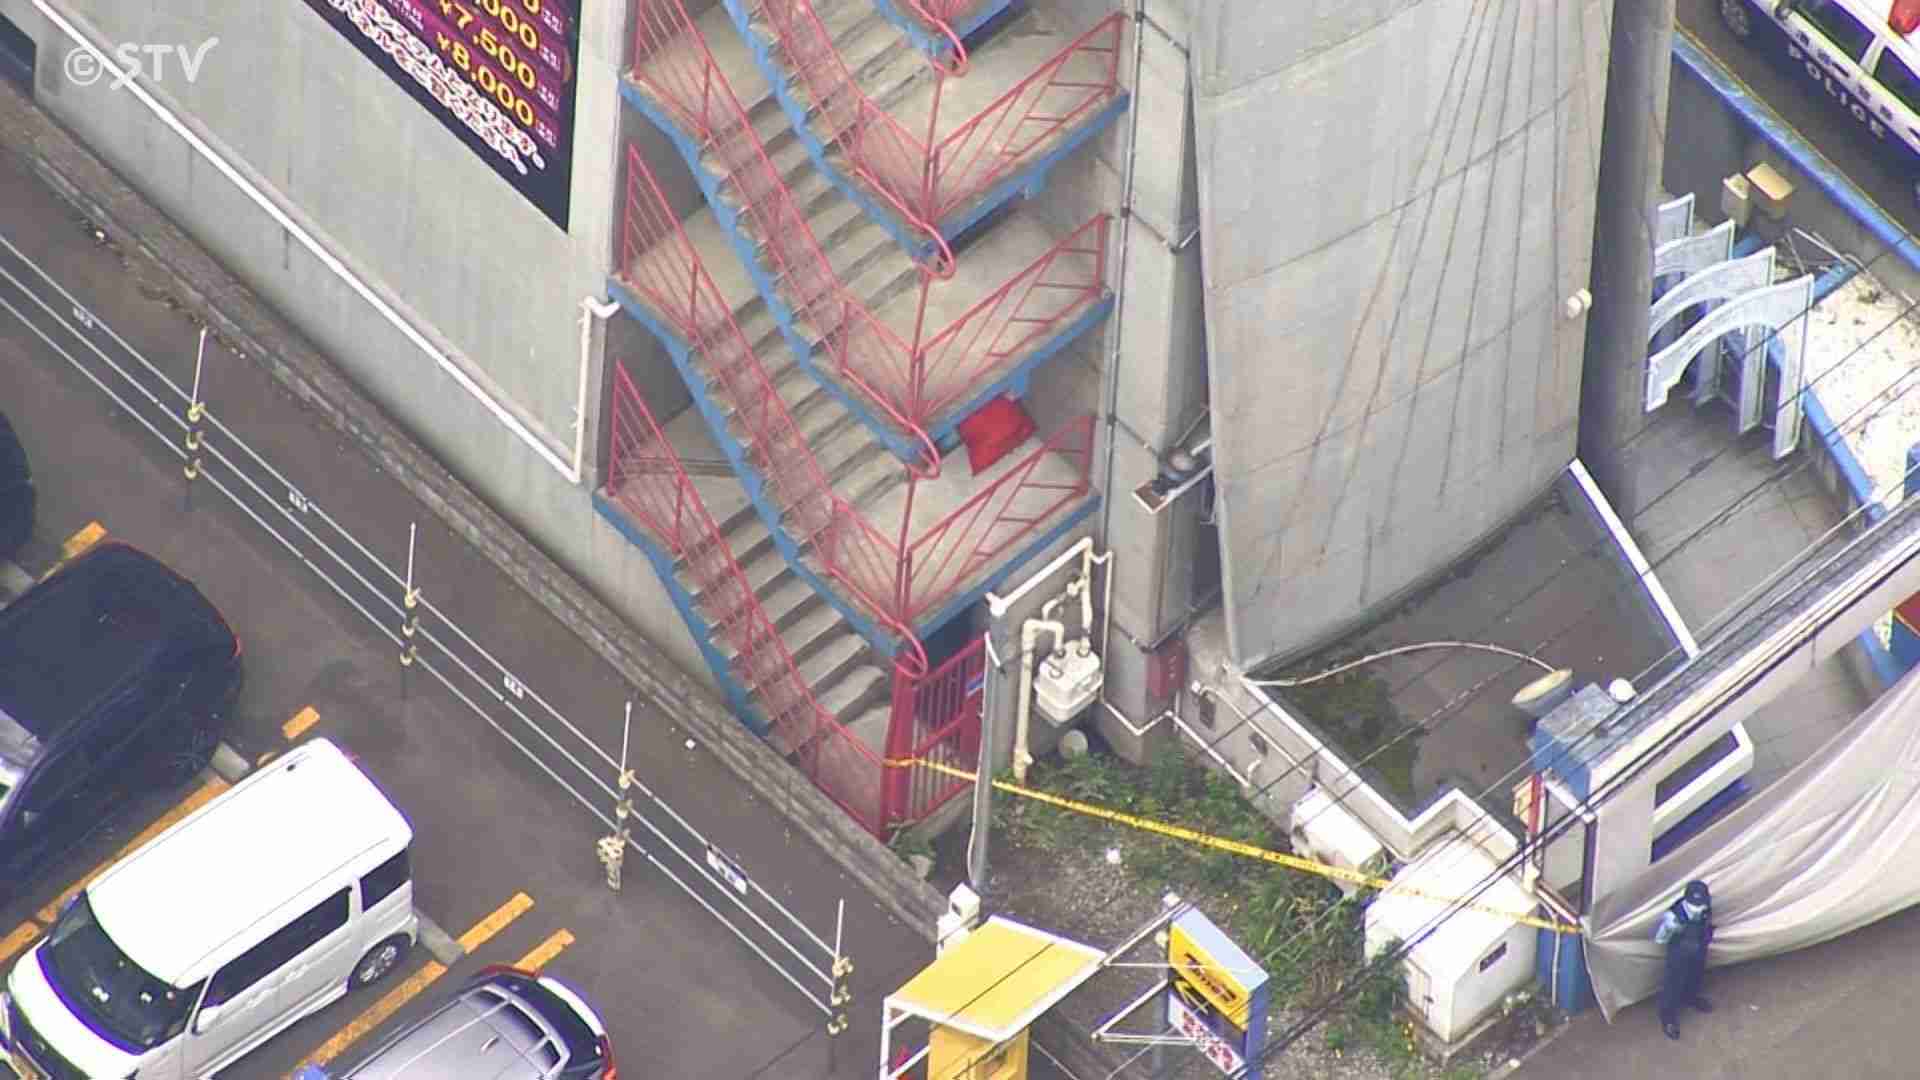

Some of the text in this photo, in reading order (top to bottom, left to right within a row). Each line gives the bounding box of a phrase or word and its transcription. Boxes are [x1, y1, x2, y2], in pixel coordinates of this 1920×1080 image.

[436, 31, 534, 126] ¥8,000
[440, 0, 536, 90] ¥7,500
[1789, 44, 1886, 138] POLICE
